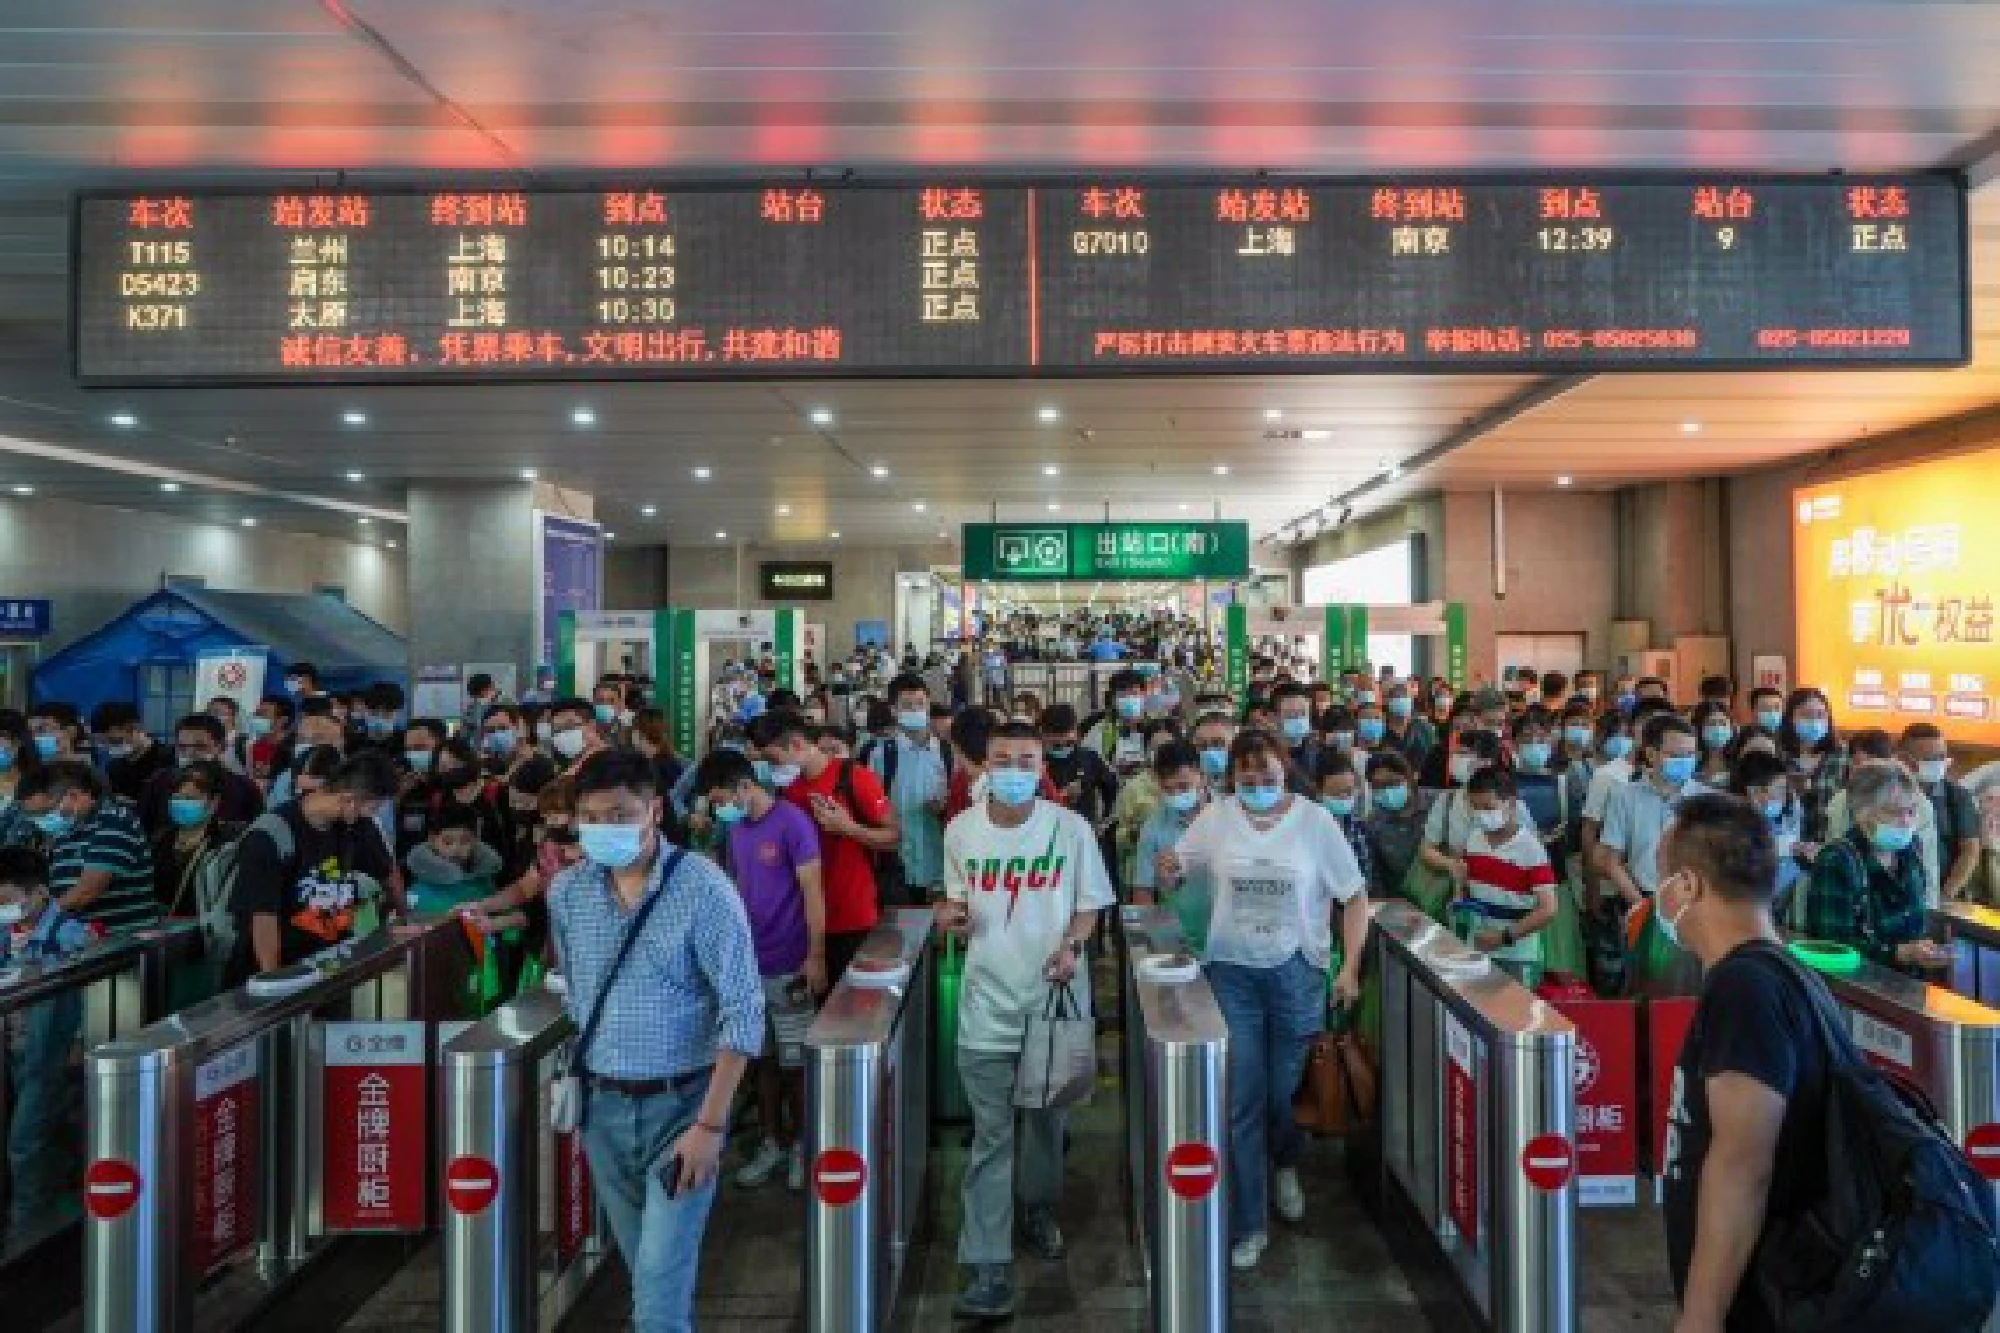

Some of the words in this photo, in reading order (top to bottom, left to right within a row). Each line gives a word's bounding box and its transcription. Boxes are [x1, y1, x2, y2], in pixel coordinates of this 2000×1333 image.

[130, 196, 193, 228] 车次
[273, 194, 370, 228] 始发站
[430, 192, 527, 226] 终到站
[604, 189, 667, 224] 到点
[761, 188, 825, 222] 站台
[919, 186, 983, 219] 状态
[1080, 187, 1145, 218] 车次
[1217, 188, 1310, 221] 始发站
[1370, 188, 1464, 222] 终到站
[1540, 187, 1601, 218] 到点
[1692, 186, 1754, 218] 站台
[1847, 185, 1909, 218] 状态
[130, 241, 190, 264] T115
[290, 234, 347, 264] 兰州
[448, 232, 506, 263] 上海
[597, 233, 676, 258] 10:14
[921, 229, 981, 257] 正点
[1073, 231, 1149, 254] G7010
[1237, 226, 1296, 255] 上海
[1392, 226, 1451, 256] 南京
[1537, 226, 1613, 250] 12:39
[1716, 226, 1736, 250] 9
[1852, 224, 1910, 253] 正点
[122, 272, 201, 296] D5423
[448, 265, 506, 296] 南京
[597, 266, 676, 290] 10:23
[921, 260, 981, 288] 正点
[130, 304, 187, 328] K371
[289, 299, 347, 328] 太原
[448, 297, 506, 327] 上海
[597, 298, 676, 322] 10:30
[921, 292, 981, 320] 正点
